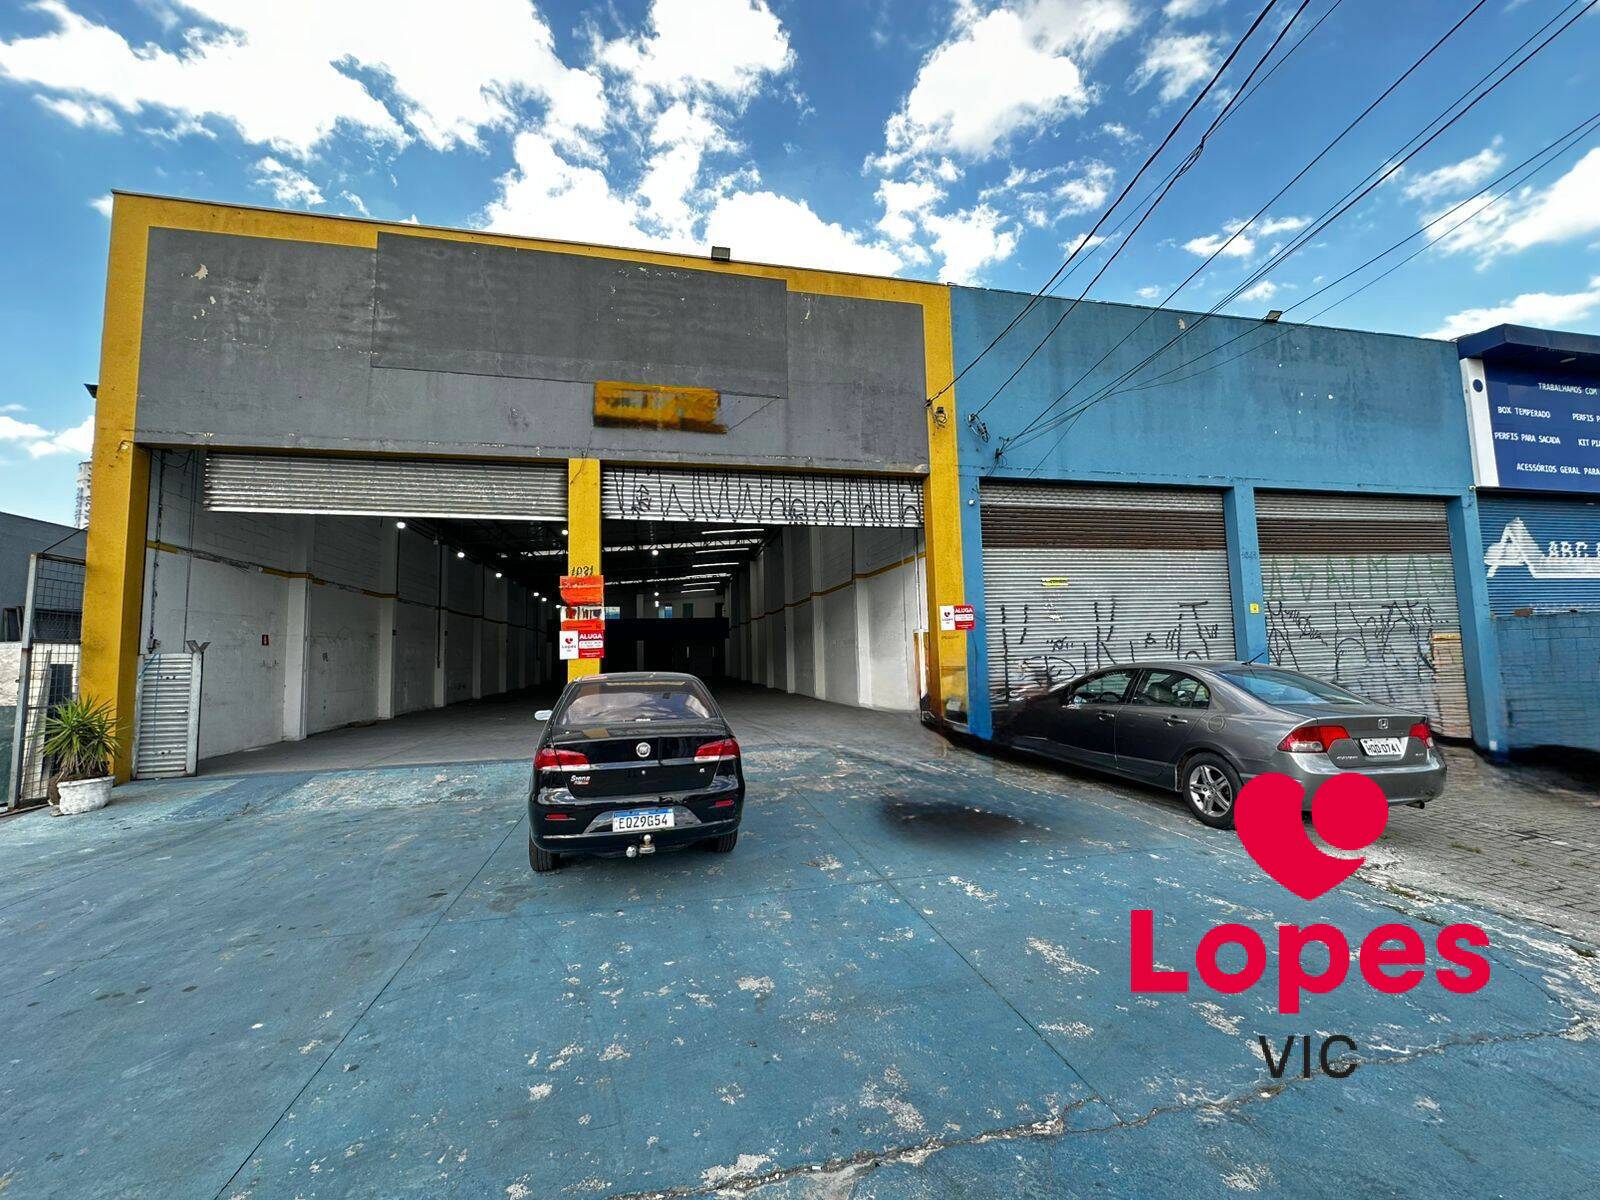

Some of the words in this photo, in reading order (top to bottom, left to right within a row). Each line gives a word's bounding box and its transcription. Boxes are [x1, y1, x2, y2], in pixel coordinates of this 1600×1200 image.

[1538, 382, 1582, 394] TRABALHAMOS
[1584, 387, 1598, 395] COM
[1497, 406, 1512, 414] BOX
[1514, 407, 1551, 418] TEMPERADO
[1572, 413, 1594, 422] PERFIS
[1494, 432, 1519, 440] PERFIS
[1521, 434, 1536, 442] PARA
[1538, 435, 1561, 444] SACADA
[1578, 438, 1590, 446] KIT
[1516, 462, 1557, 473] ACESSÓRIOS
[1560, 466, 1580, 474] GERAL
[618, 814, 668, 829] EQZ9G54
